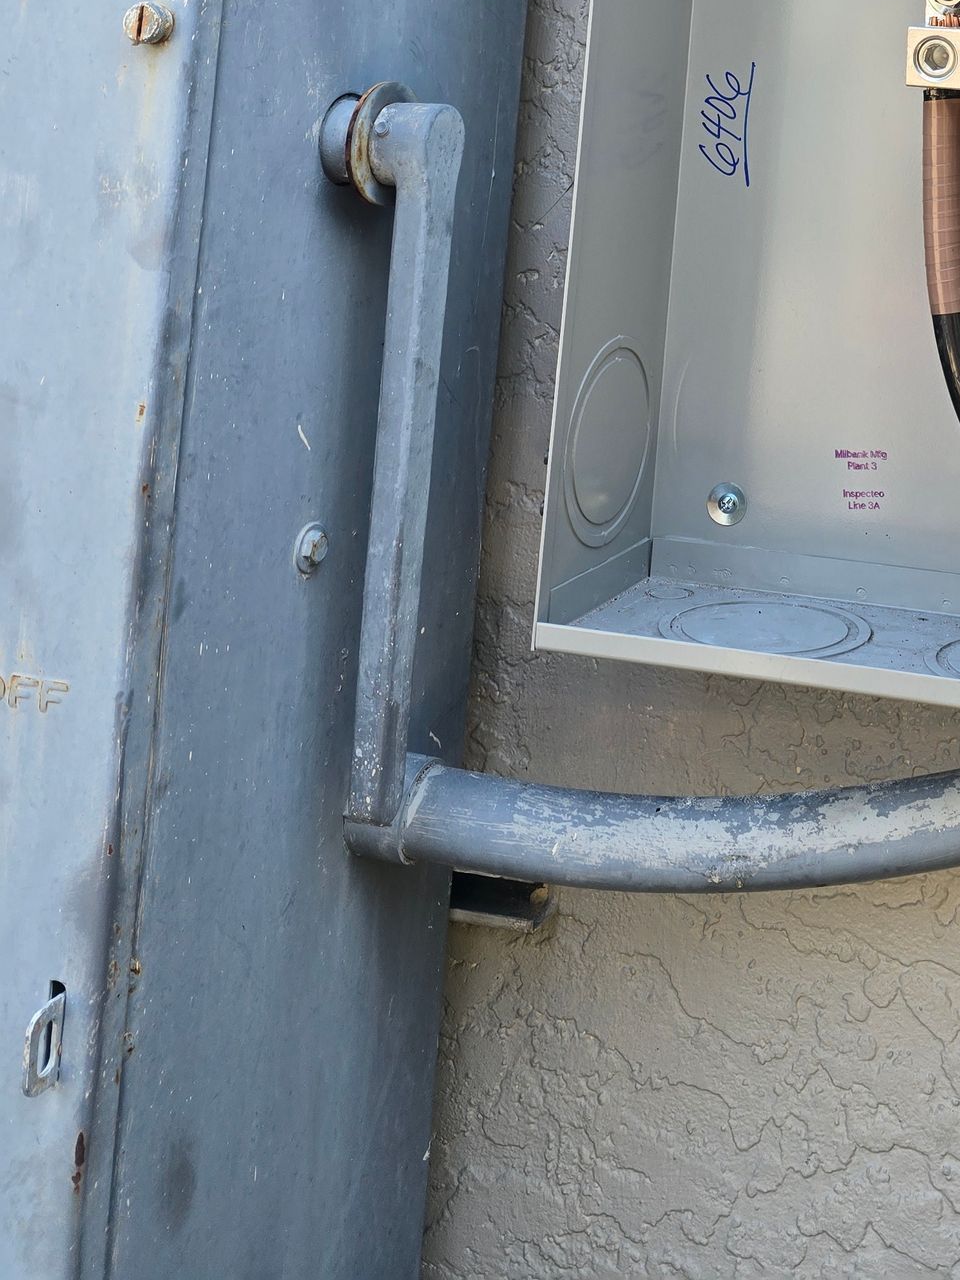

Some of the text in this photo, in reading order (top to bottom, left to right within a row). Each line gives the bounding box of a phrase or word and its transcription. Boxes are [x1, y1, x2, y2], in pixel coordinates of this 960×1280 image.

[835, 449, 869, 458] Milbank
[847, 461, 878, 471] Plant 3
[848, 501, 880, 510] Line 3A
[0, 674, 69, 714] FF
